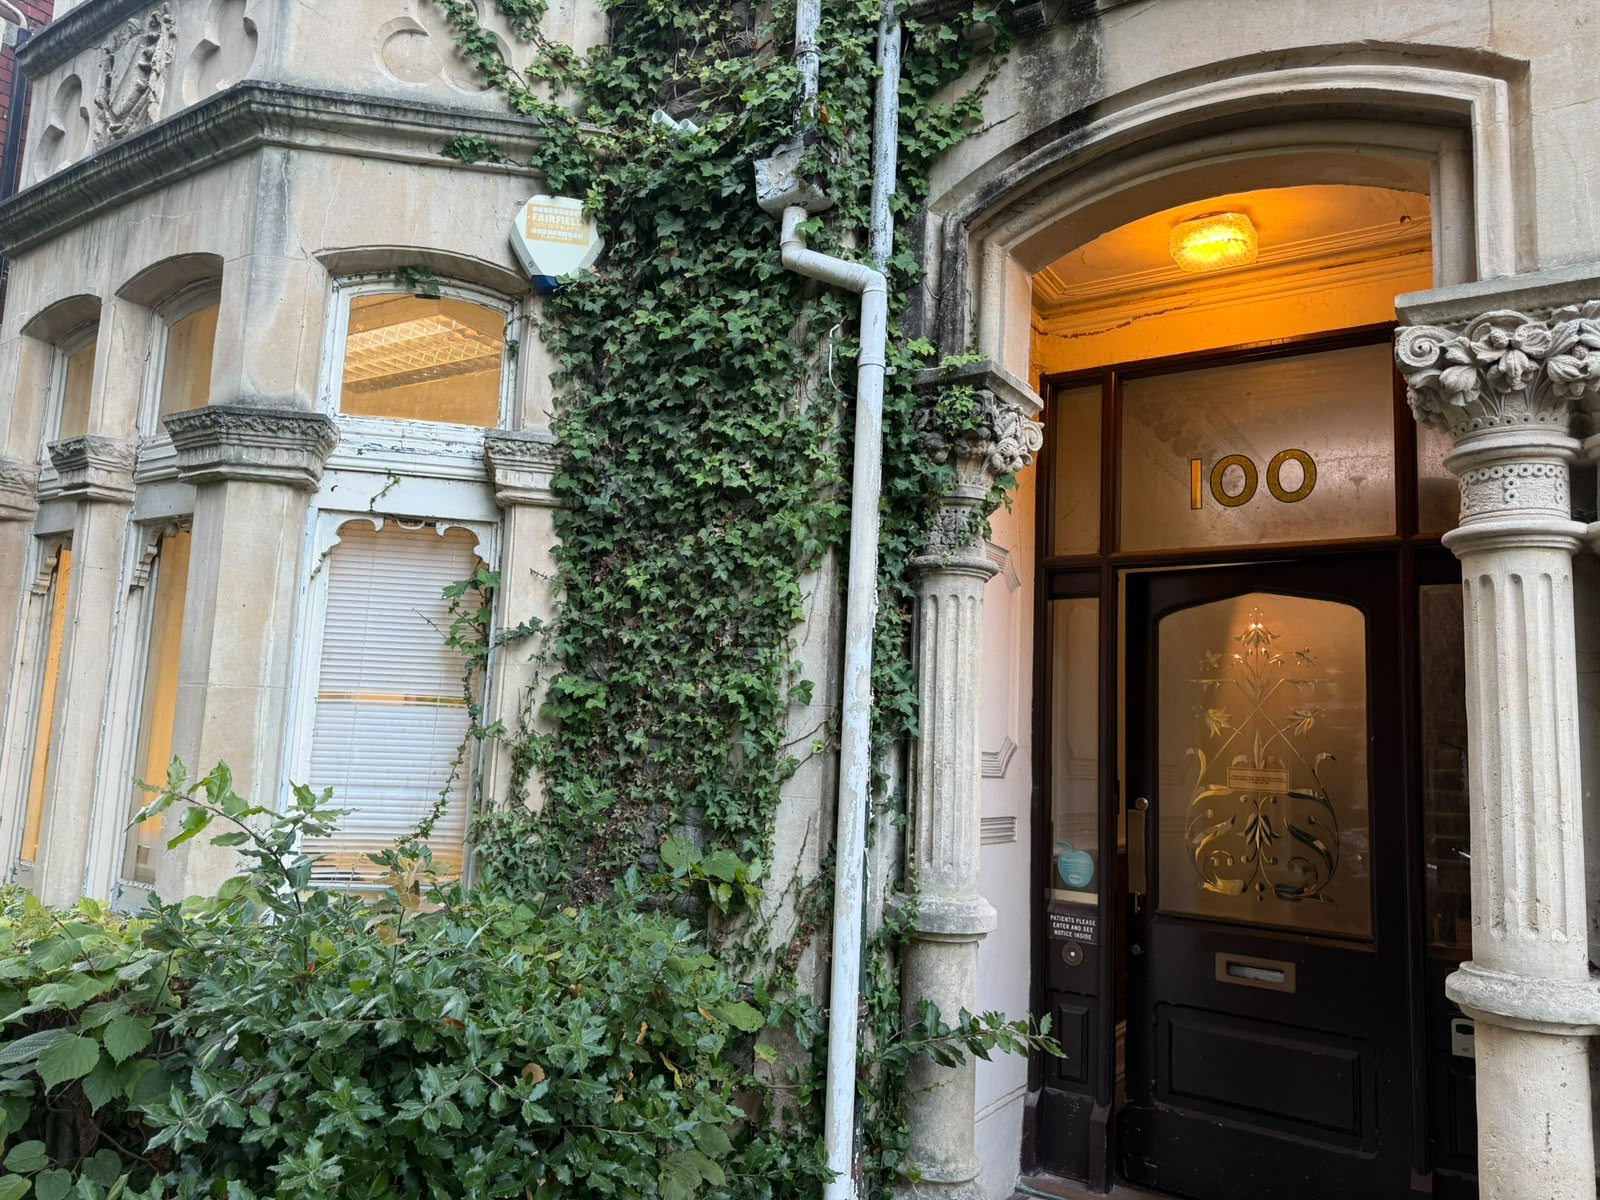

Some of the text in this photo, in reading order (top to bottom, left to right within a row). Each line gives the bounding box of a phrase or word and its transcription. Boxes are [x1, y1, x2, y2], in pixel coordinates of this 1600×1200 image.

[1191, 449, 1317, 510] 100
[1050, 915, 1096, 926] PATIENTS PLEASE
[1053, 922, 1070, 930] ENTER
[1074, 932, 1092, 940] INSIDE
